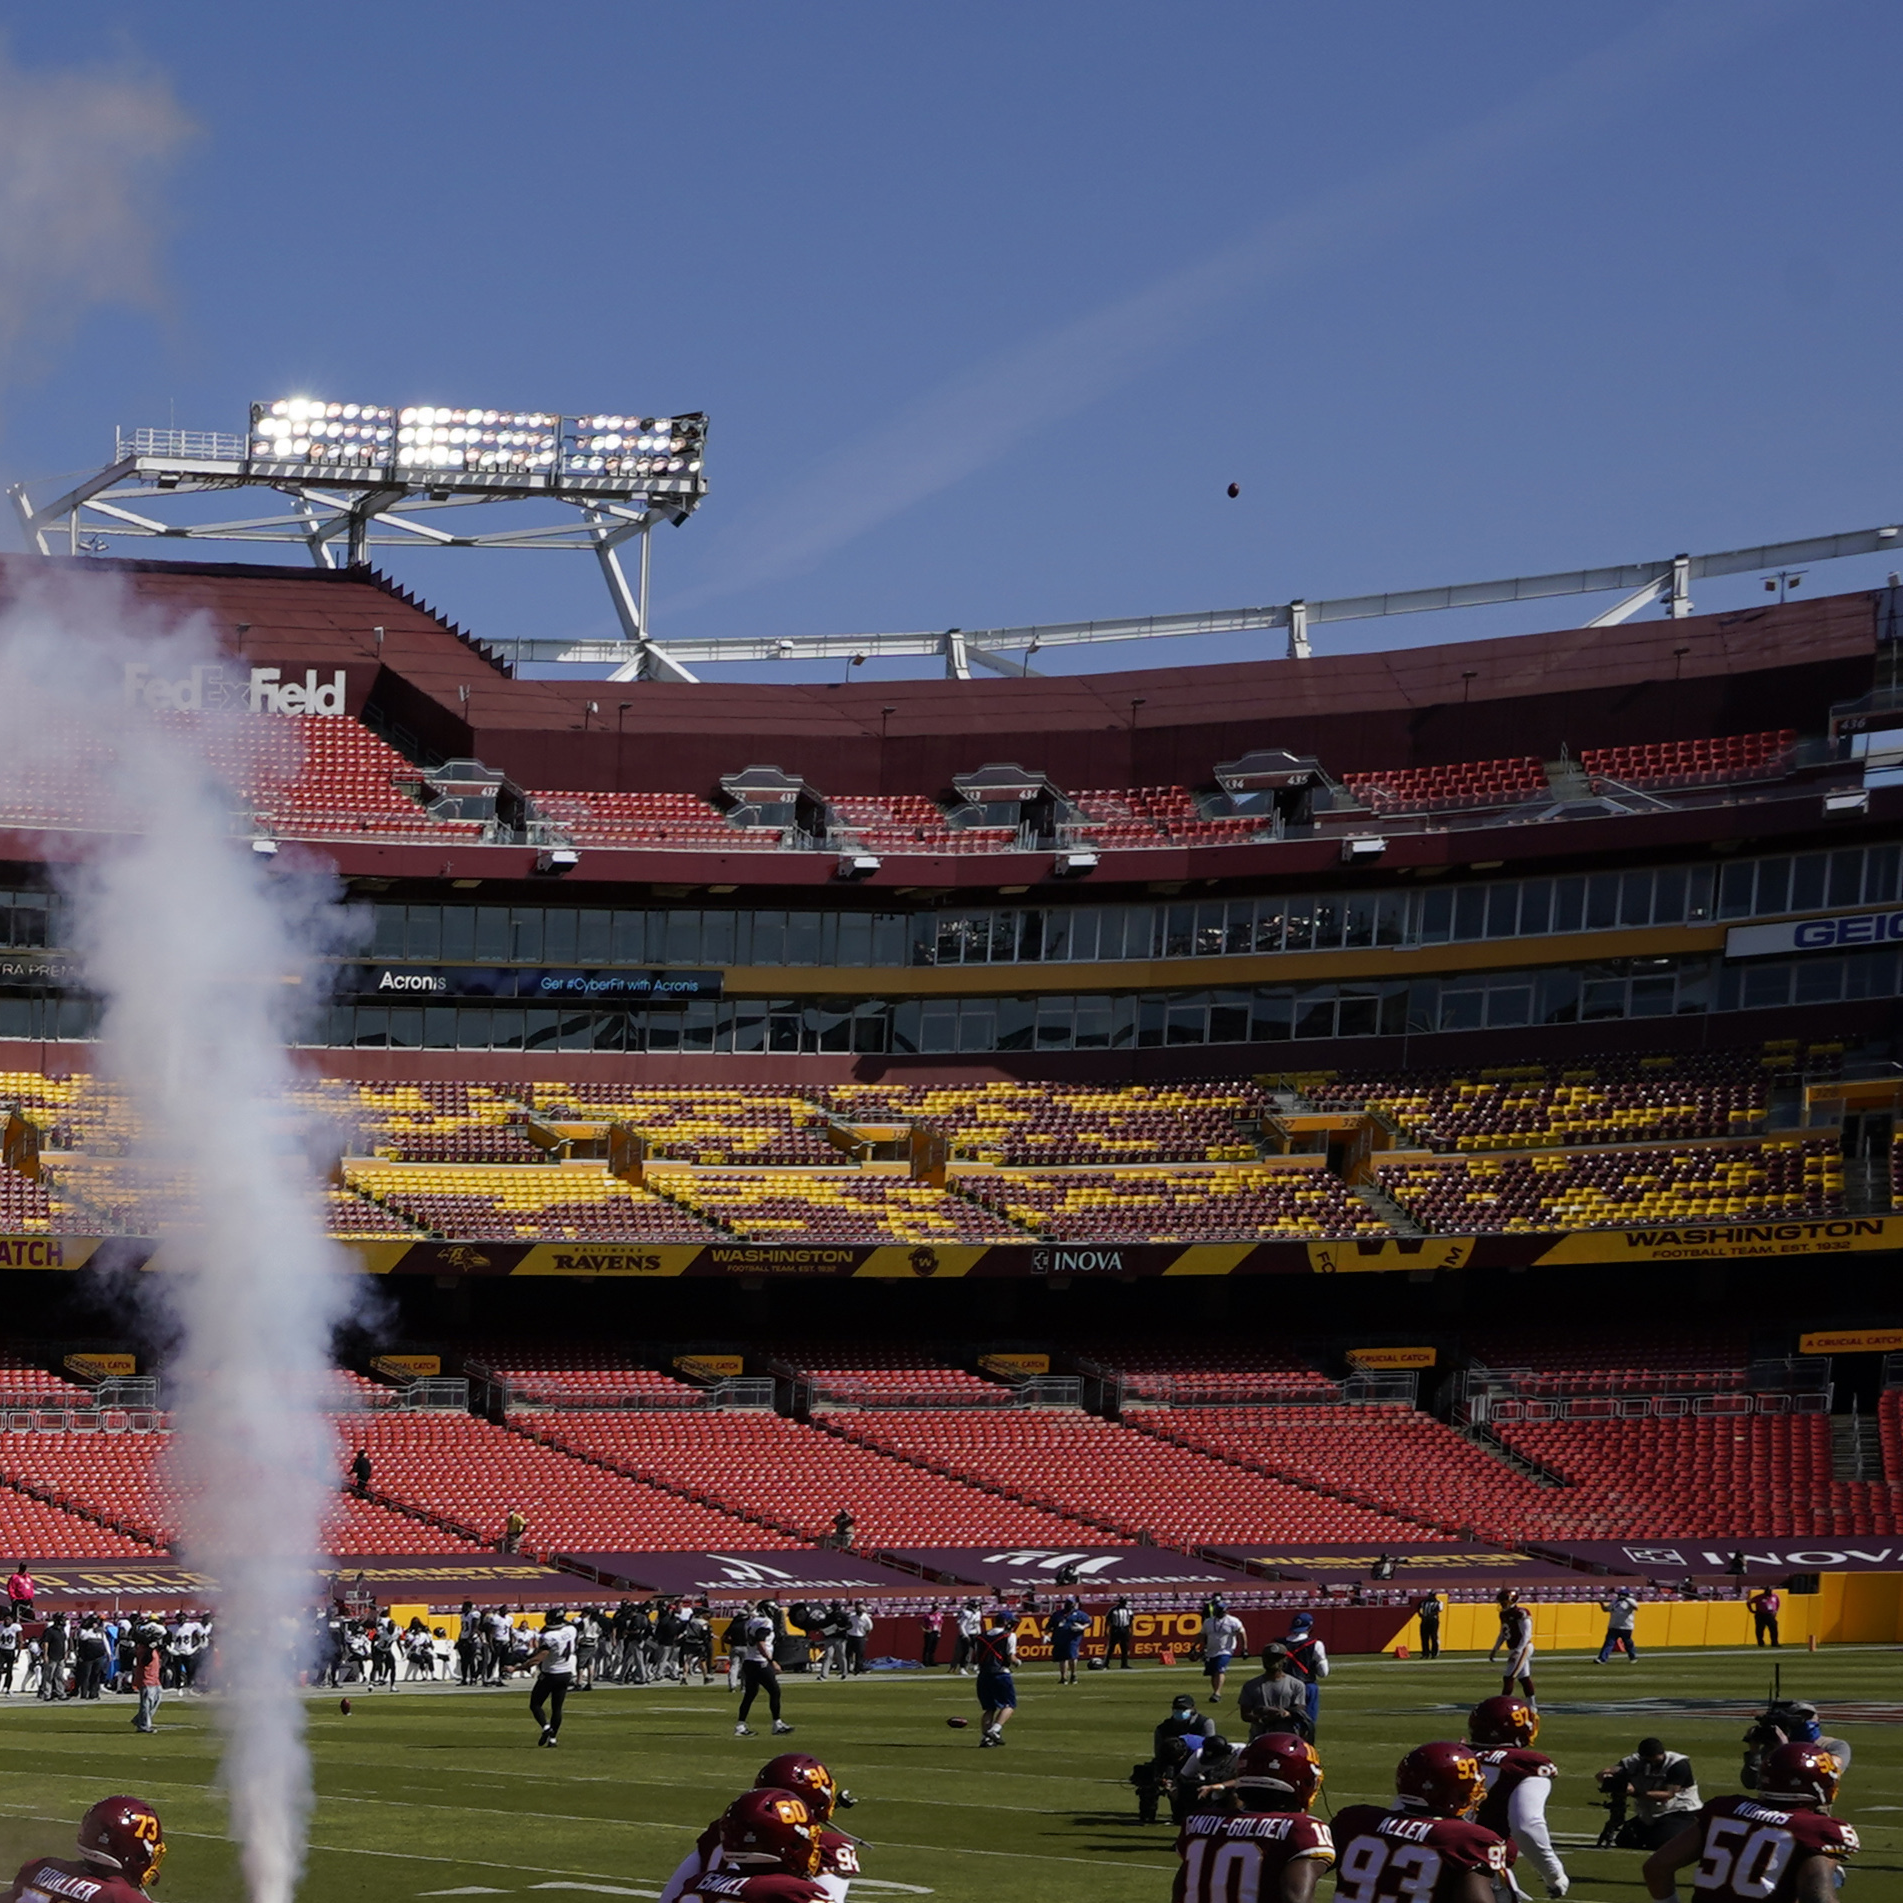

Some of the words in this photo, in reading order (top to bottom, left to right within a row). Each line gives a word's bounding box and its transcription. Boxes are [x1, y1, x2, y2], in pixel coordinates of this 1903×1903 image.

[124, 662, 346, 714] FedExField
[379, 971, 446, 990] Acronis
[540, 977, 564, 991] Get
[566, 977, 624, 994] #CyberFit
[627, 978, 651, 991] with
[654, 979, 699, 992] Acronis
[1625, 1220, 1884, 1247] WASHINGTON
[713, 1249, 853, 1263] WASHINGTON
[1652, 1247, 1726, 1259] FOOTBALL
[1730, 1245, 1775, 1257] TEAM,
[1780, 1243, 1809, 1254] EST.
[1816, 1241, 1851, 1252] 1932
[552, 1254, 663, 1274] RAVENS
[1054, 1251, 1122, 1271] INOVA
[1817, 1339, 1862, 1348] CRUCIAL
[1865, 1336, 1902, 1345] CATCH
[1116, 1575, 1226, 1585] AMERICA
[1134, 1640, 1163, 1657] EST.
[1510, 1705, 1530, 1728] 97
[1484, 1748, 1508, 1765] JR
[1456, 1757, 1480, 1781] 93
[775, 1800, 808, 1824] 60
[133, 1814, 159, 1841] 73
[1376, 1815, 1433, 1843] ALLEN
[1695, 1816, 1795, 1899] 50
